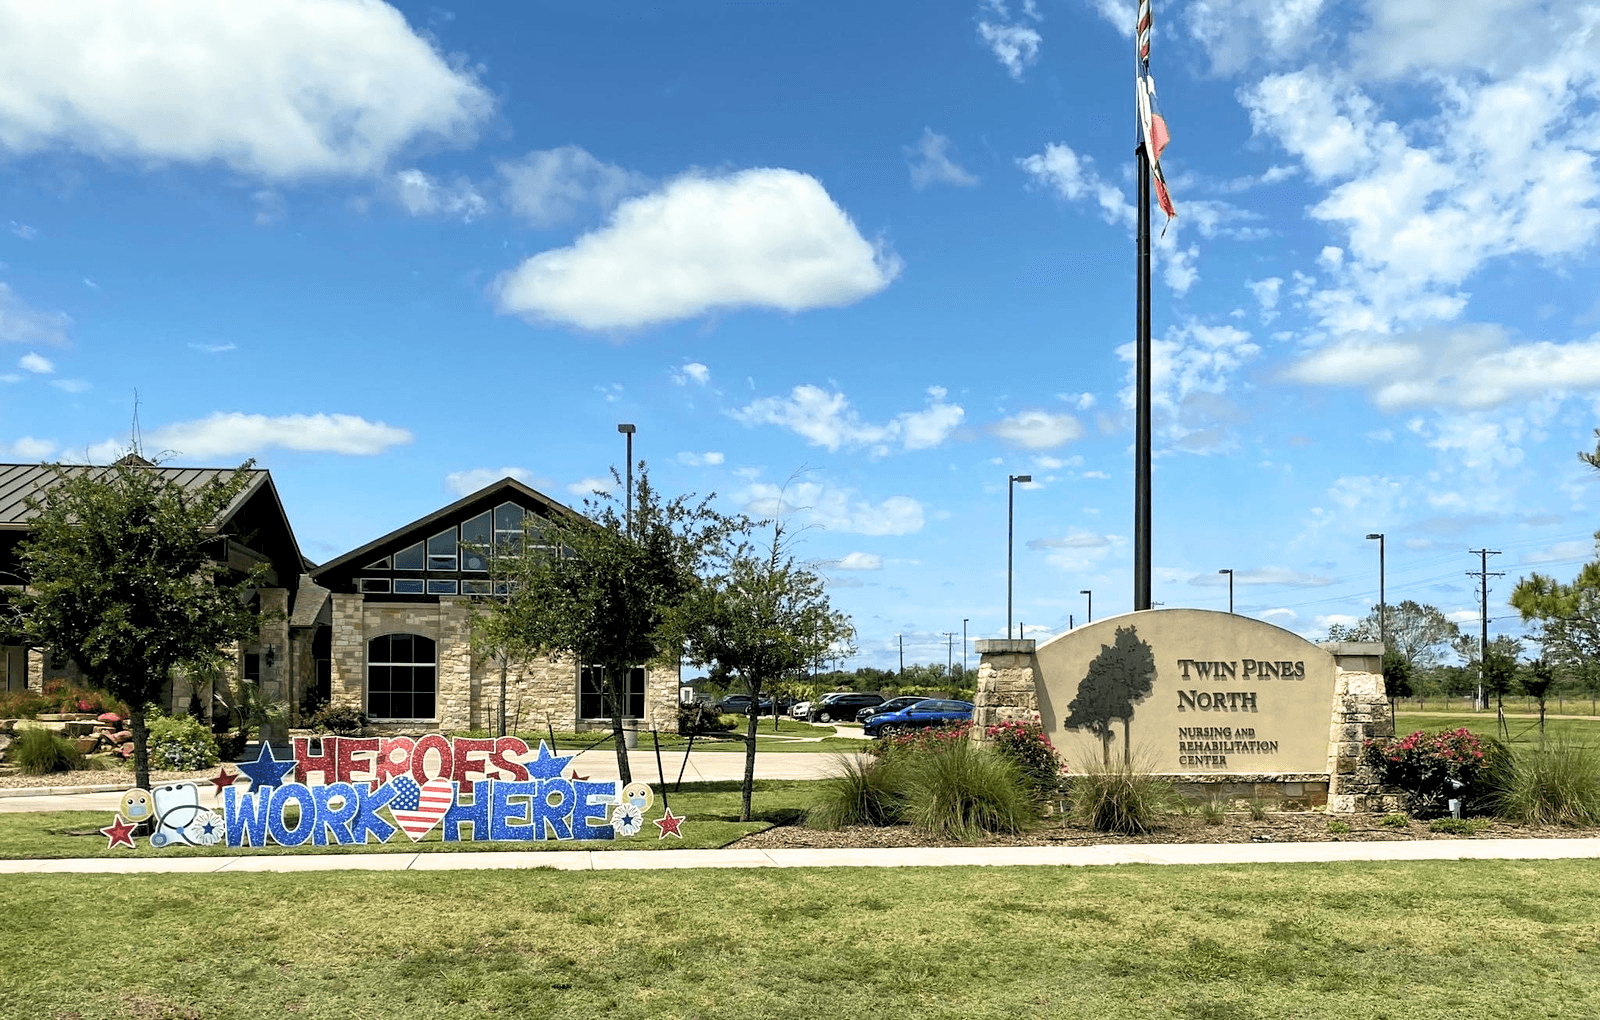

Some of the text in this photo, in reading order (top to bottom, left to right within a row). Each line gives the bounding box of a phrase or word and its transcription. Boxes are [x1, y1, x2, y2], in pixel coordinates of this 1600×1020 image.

[1178, 727, 1255, 738] NURSING AND
[1179, 741, 1278, 752] REHABILITATION
[292, 735, 530, 793] HEROES
[1179, 755, 1227, 766] CENTER
[224, 779, 616, 847] WORK HERE
